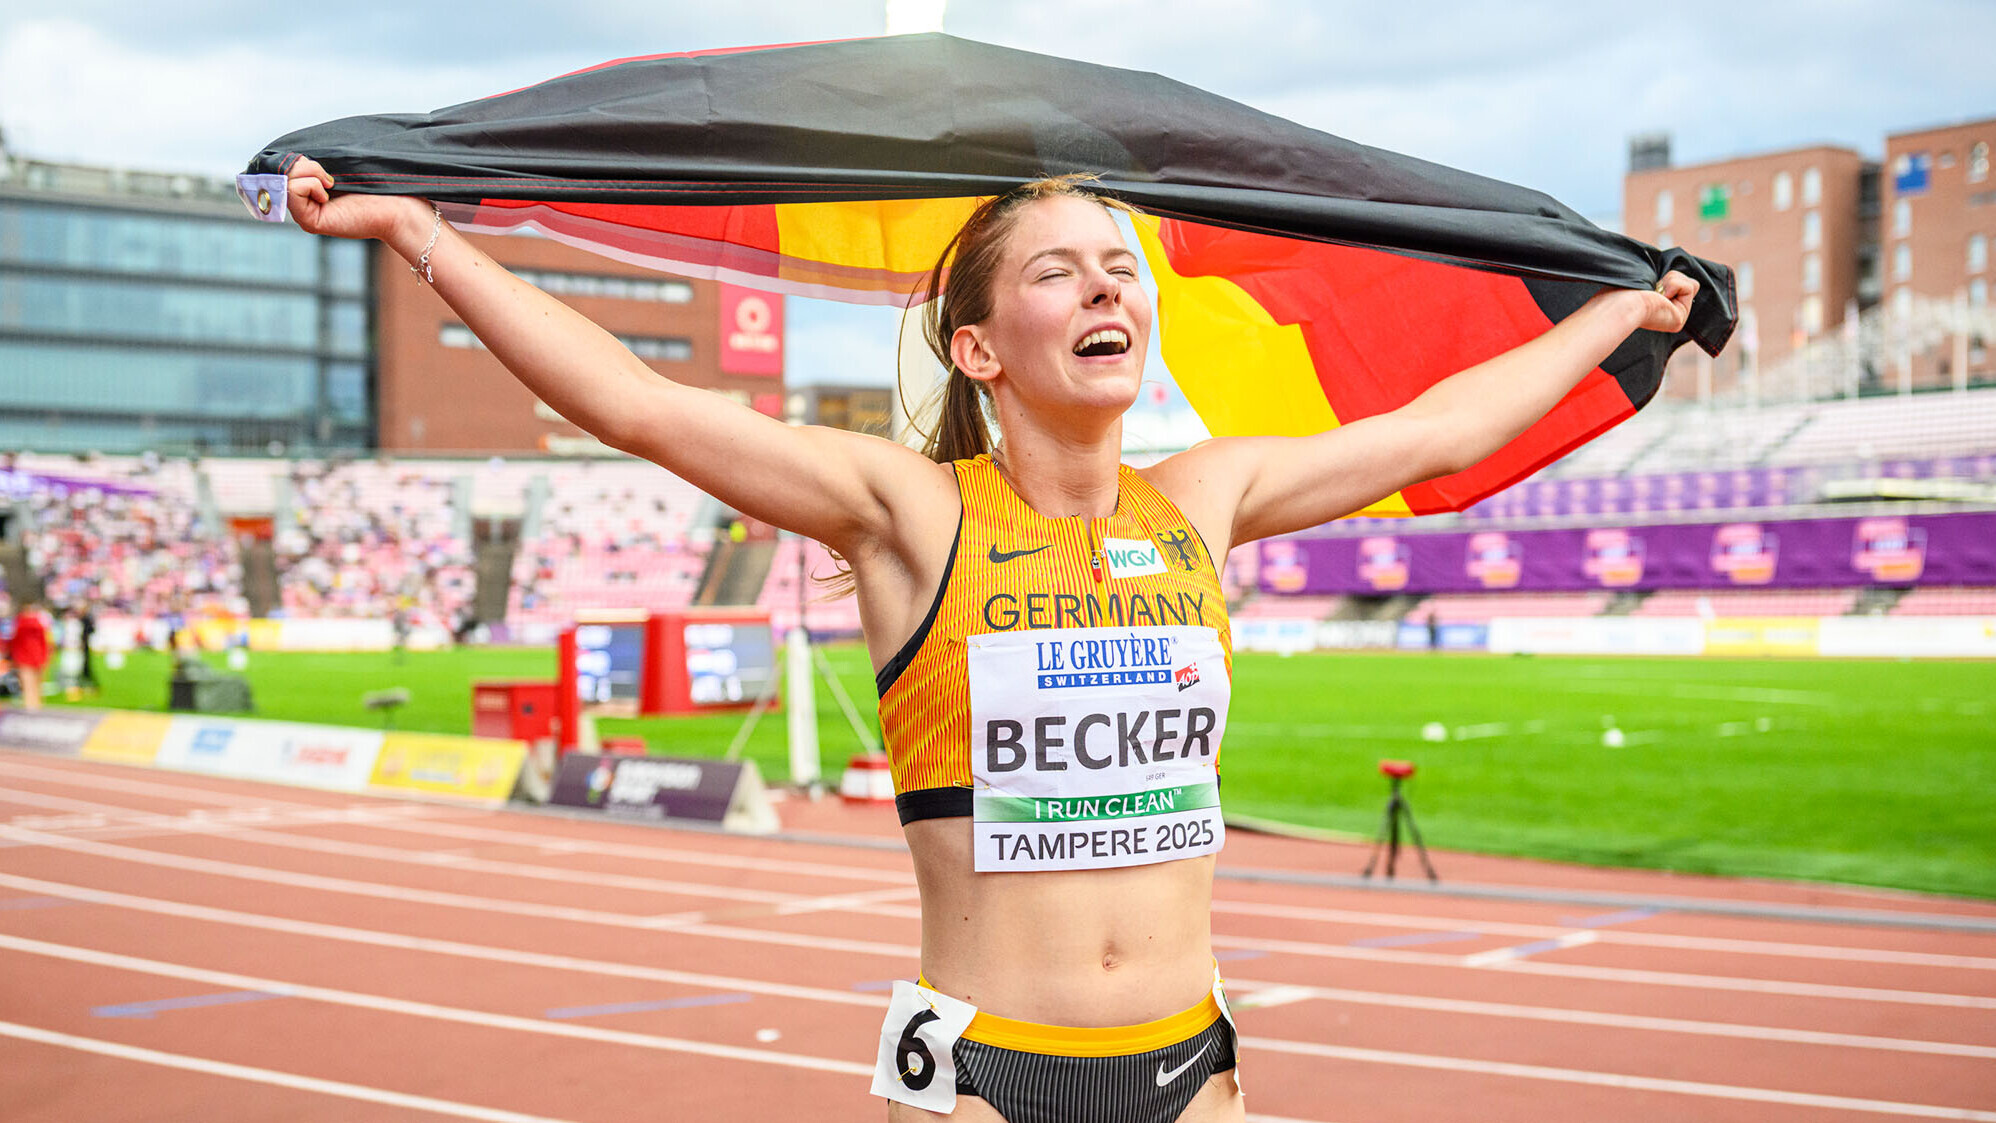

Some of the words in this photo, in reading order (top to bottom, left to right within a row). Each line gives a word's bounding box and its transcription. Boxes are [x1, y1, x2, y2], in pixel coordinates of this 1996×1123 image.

[1107, 547, 1155, 569] WGV
[983, 592, 1204, 631] GERMANY
[1036, 641, 1065, 671] LE
[1044, 671, 1167, 687] SWITZERLAND
[986, 707, 1216, 773] BECKER
[1035, 801, 1041, 819] I
[1047, 800, 1100, 819] RUN
[990, 827, 1148, 861] TAMPERE
[1156, 819, 1214, 851] 2025
[896, 1008, 941, 1091] 6
